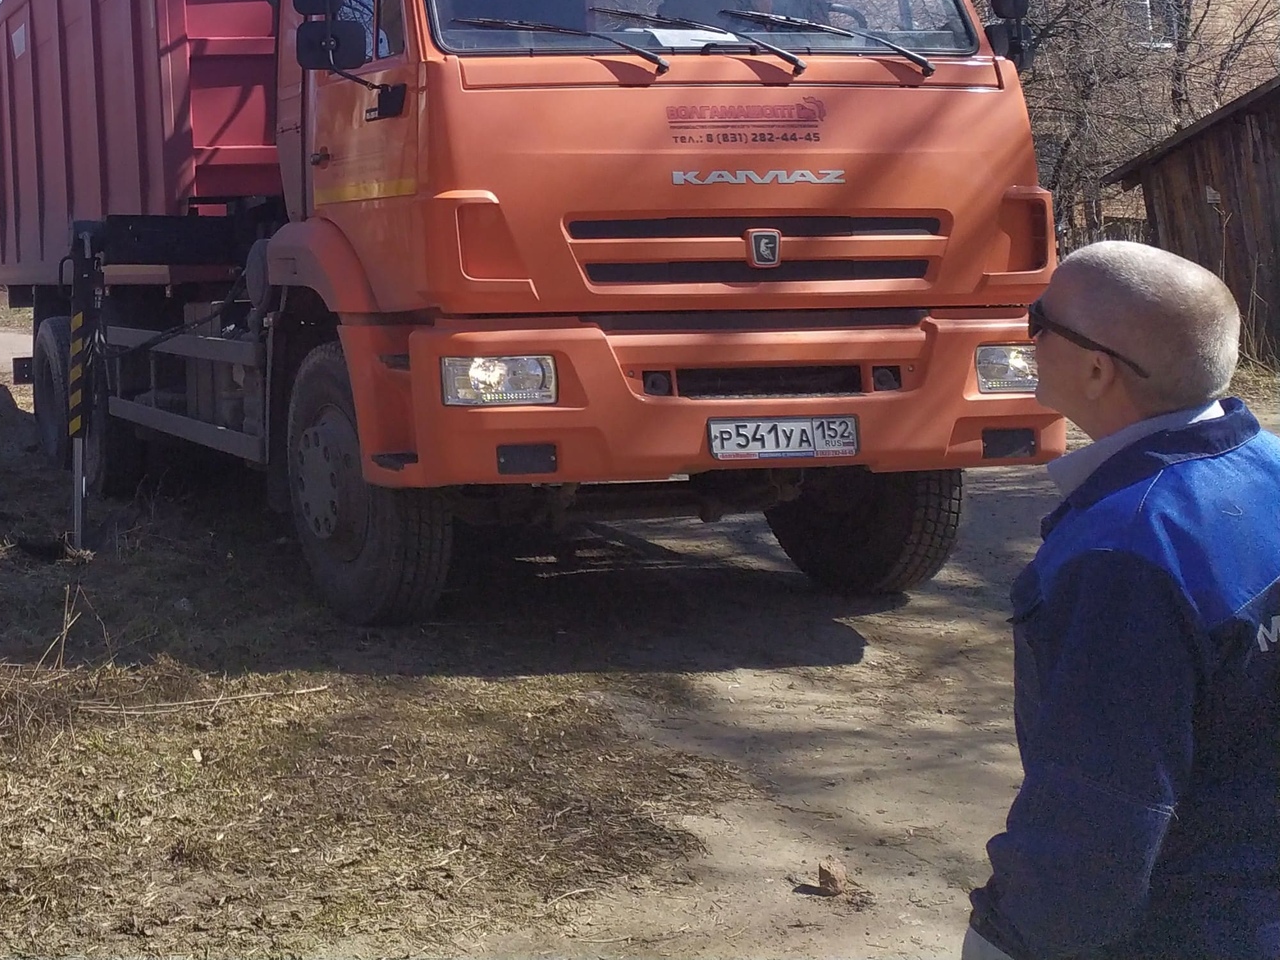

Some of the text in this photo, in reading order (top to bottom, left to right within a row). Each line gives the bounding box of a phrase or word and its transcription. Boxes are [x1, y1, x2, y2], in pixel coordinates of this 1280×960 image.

[666, 105, 795, 120] ВОЛГАМАШОПТ
[716, 133, 749, 144] (831)
[751, 132, 821, 143] 282-44-45
[672, 169, 846, 185] KAMAZ
[815, 420, 850, 439] 152
[825, 439, 843, 447] RUS
